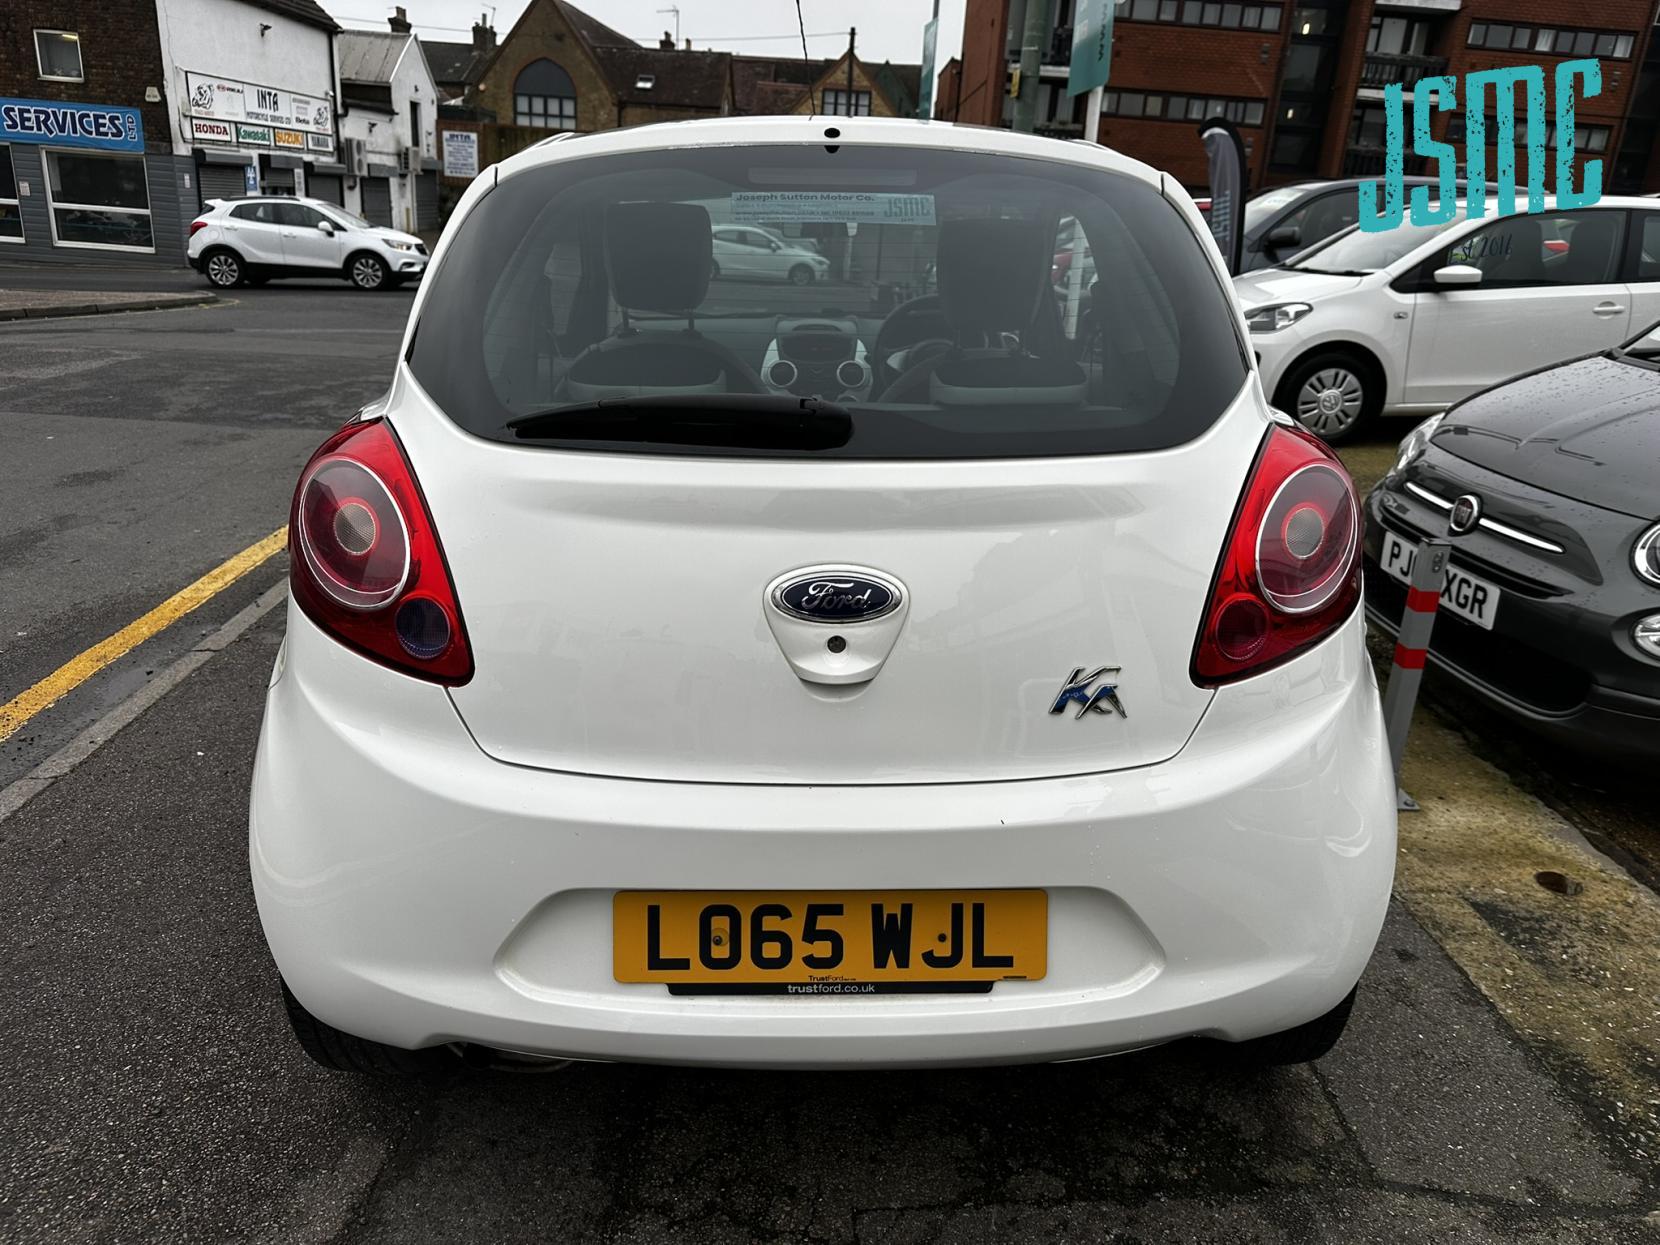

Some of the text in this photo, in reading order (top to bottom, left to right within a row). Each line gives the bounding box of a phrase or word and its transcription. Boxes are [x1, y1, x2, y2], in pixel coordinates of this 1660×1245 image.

[257, 88, 279, 113] INTA
[2, 104, 137, 142] SERVICES LTD
[194, 123, 229, 136] HONDA
[237, 125, 271, 142] Kawasaki
[275, 131, 304, 146] SUZUKI
[736, 194, 778, 203] Joseph
[855, 194, 875, 202] Co.
[884, 197, 931, 218] JSMC
[801, 581, 873, 610] Ford
[1440, 568, 1488, 619] XGR
[647, 902, 1014, 971] LO65 WJL
[787, 984, 875, 994] trustford.co.uk
